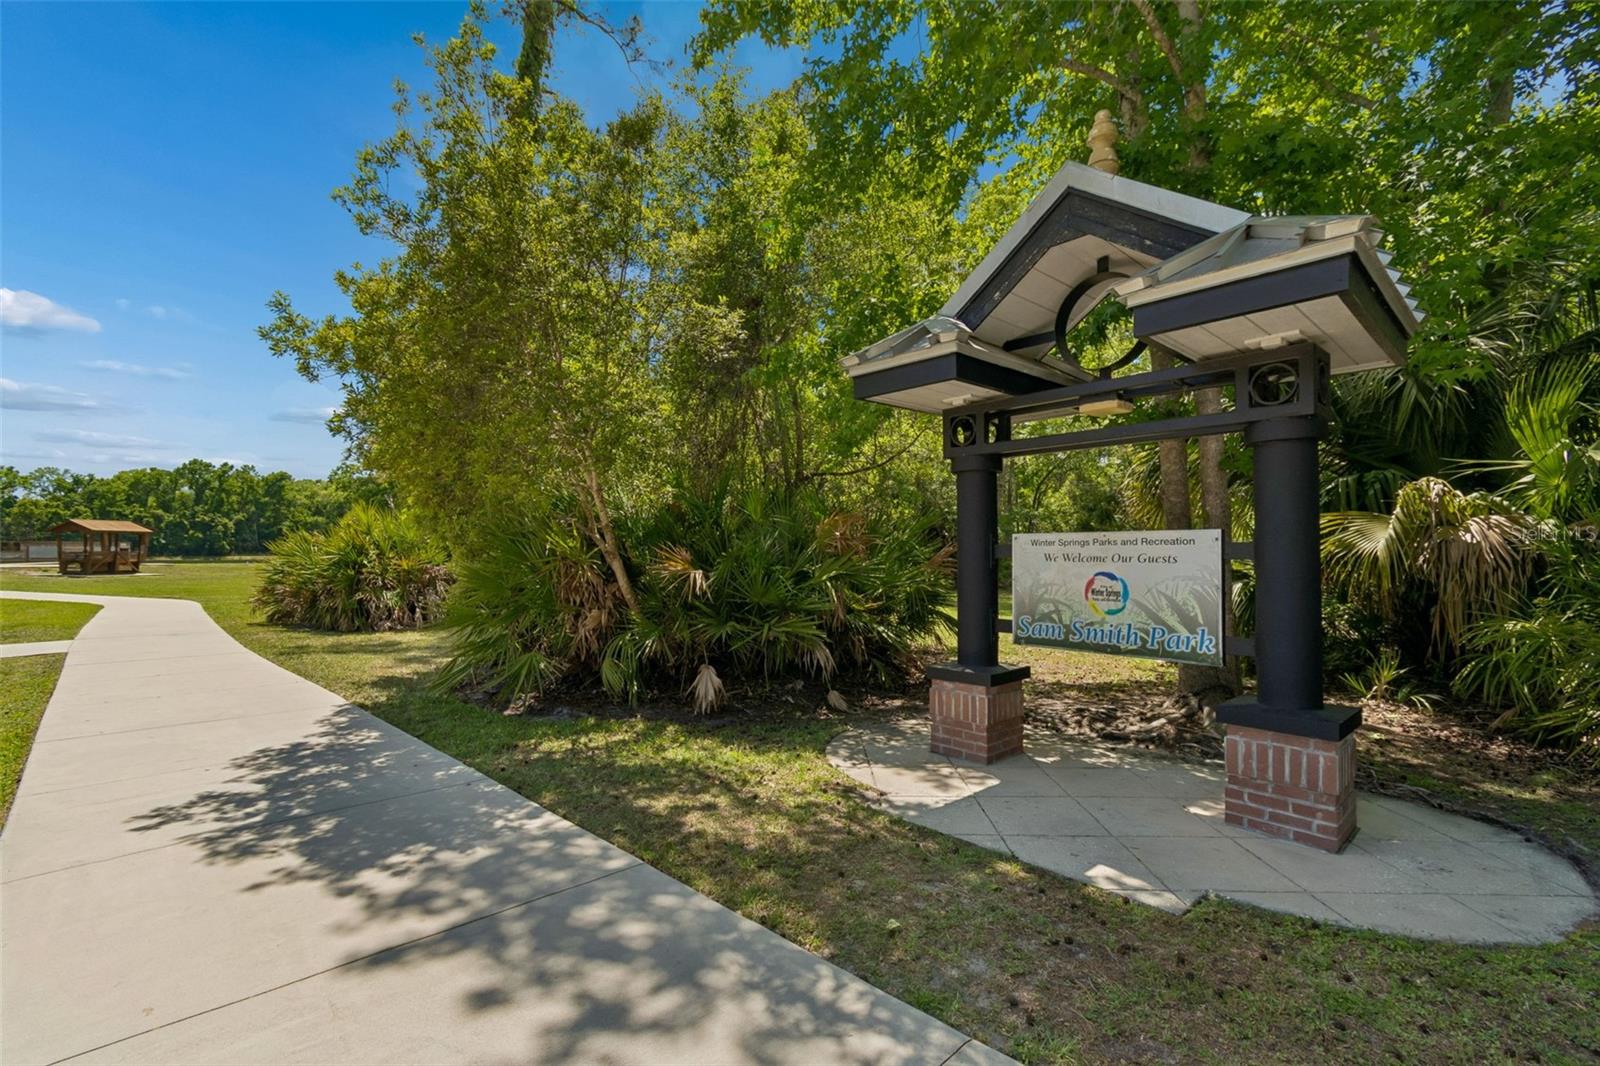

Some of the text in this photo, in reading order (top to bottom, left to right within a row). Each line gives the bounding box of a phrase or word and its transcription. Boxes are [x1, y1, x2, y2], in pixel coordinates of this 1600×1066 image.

[1030, 537, 1196, 548] Winter Springs Parks and Recreation
[1043, 552, 1179, 564] We Welcome Our Guests
[1018, 615, 1216, 654] Sam Smith Park
